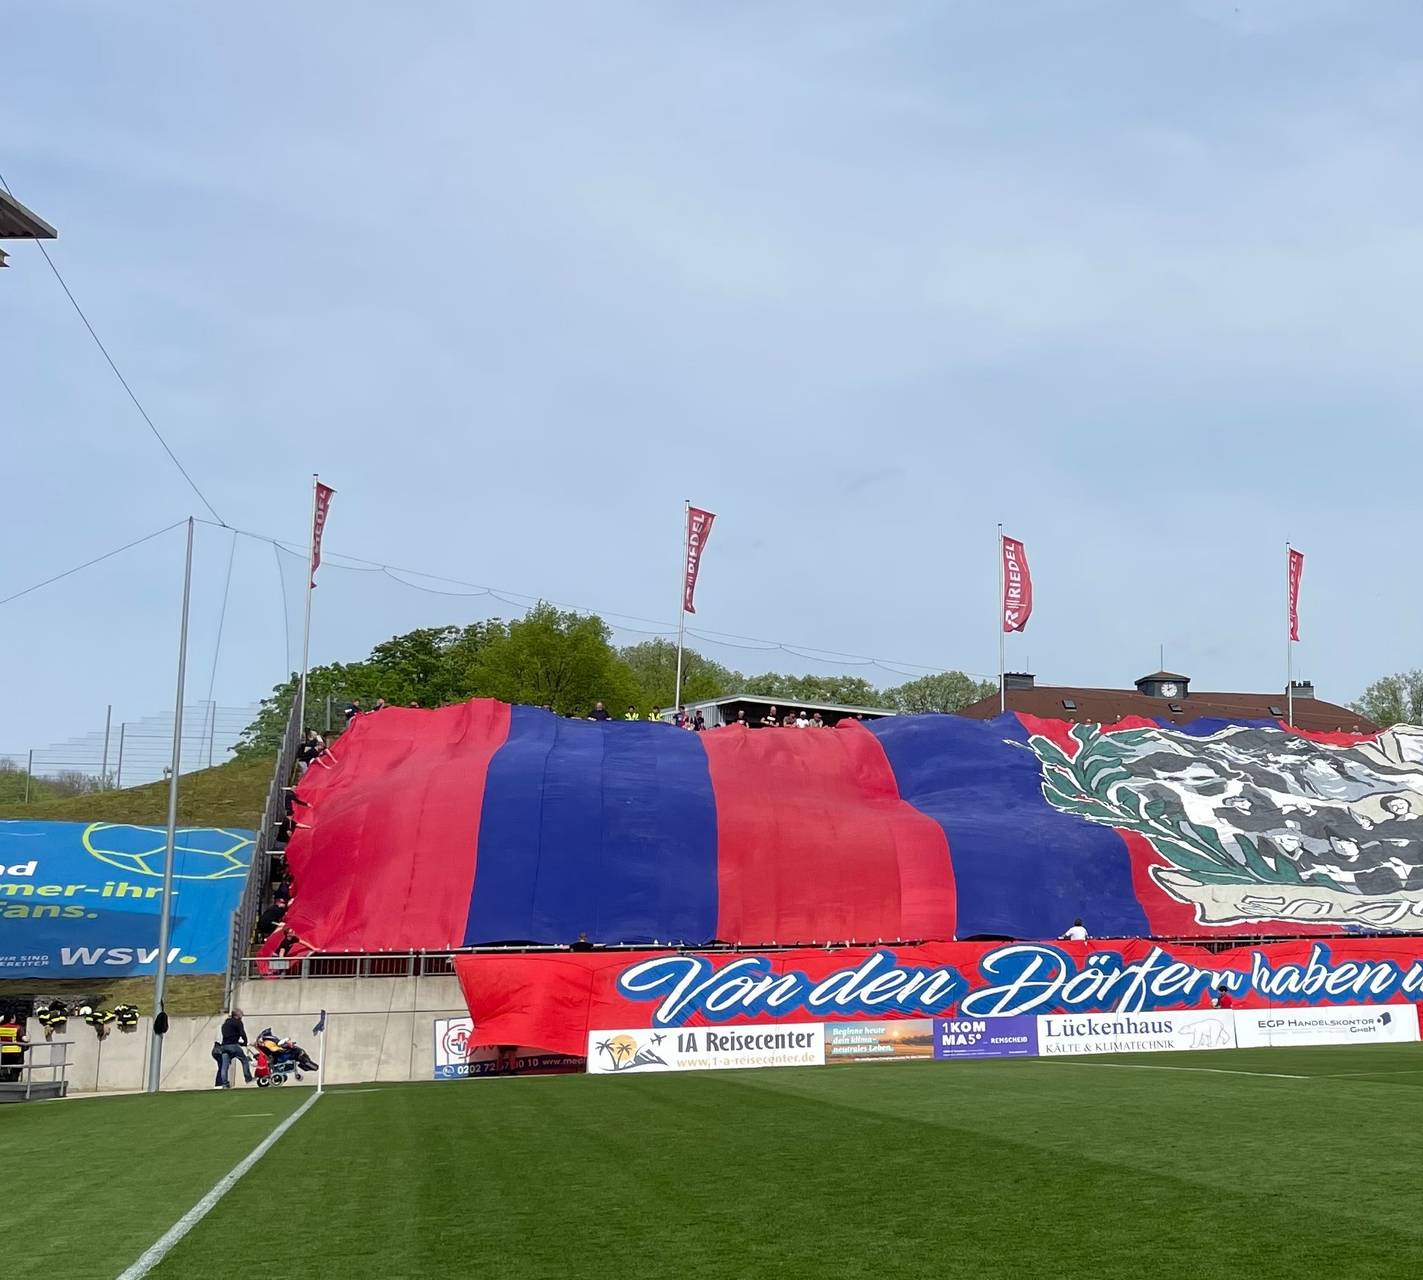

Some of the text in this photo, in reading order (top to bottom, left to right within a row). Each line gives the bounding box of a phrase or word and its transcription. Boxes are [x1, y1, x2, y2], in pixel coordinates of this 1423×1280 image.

[1004, 543, 1021, 598] RIEDEL
[0, 861, 38, 876] d
[0, 902, 98, 919] ans.
[620, 956, 803, 1024] Von
[808, 952, 958, 1006] den
[961, 945, 1243, 1017] Dörfern
[1251, 945, 1398, 996] haben
[942, 1021, 986, 1034] 1KOM
[1045, 1017, 1173, 1037] Lückenhaus
[1258, 1019, 1285, 1028] EGP
[832, 1026, 886, 1037] Beginne heute
[677, 1031, 815, 1053] 1A Reisecenter
[990, 1036, 1028, 1044] REMSCHEID
[1045, 1042, 1081, 1053] KÄLTE
[1095, 1039, 1176, 1052] KLIMATECHNIK
[676, 1052, 816, 1068] www.1-a-reisecenter.de
[457, 1064, 481, 1075] 0202
